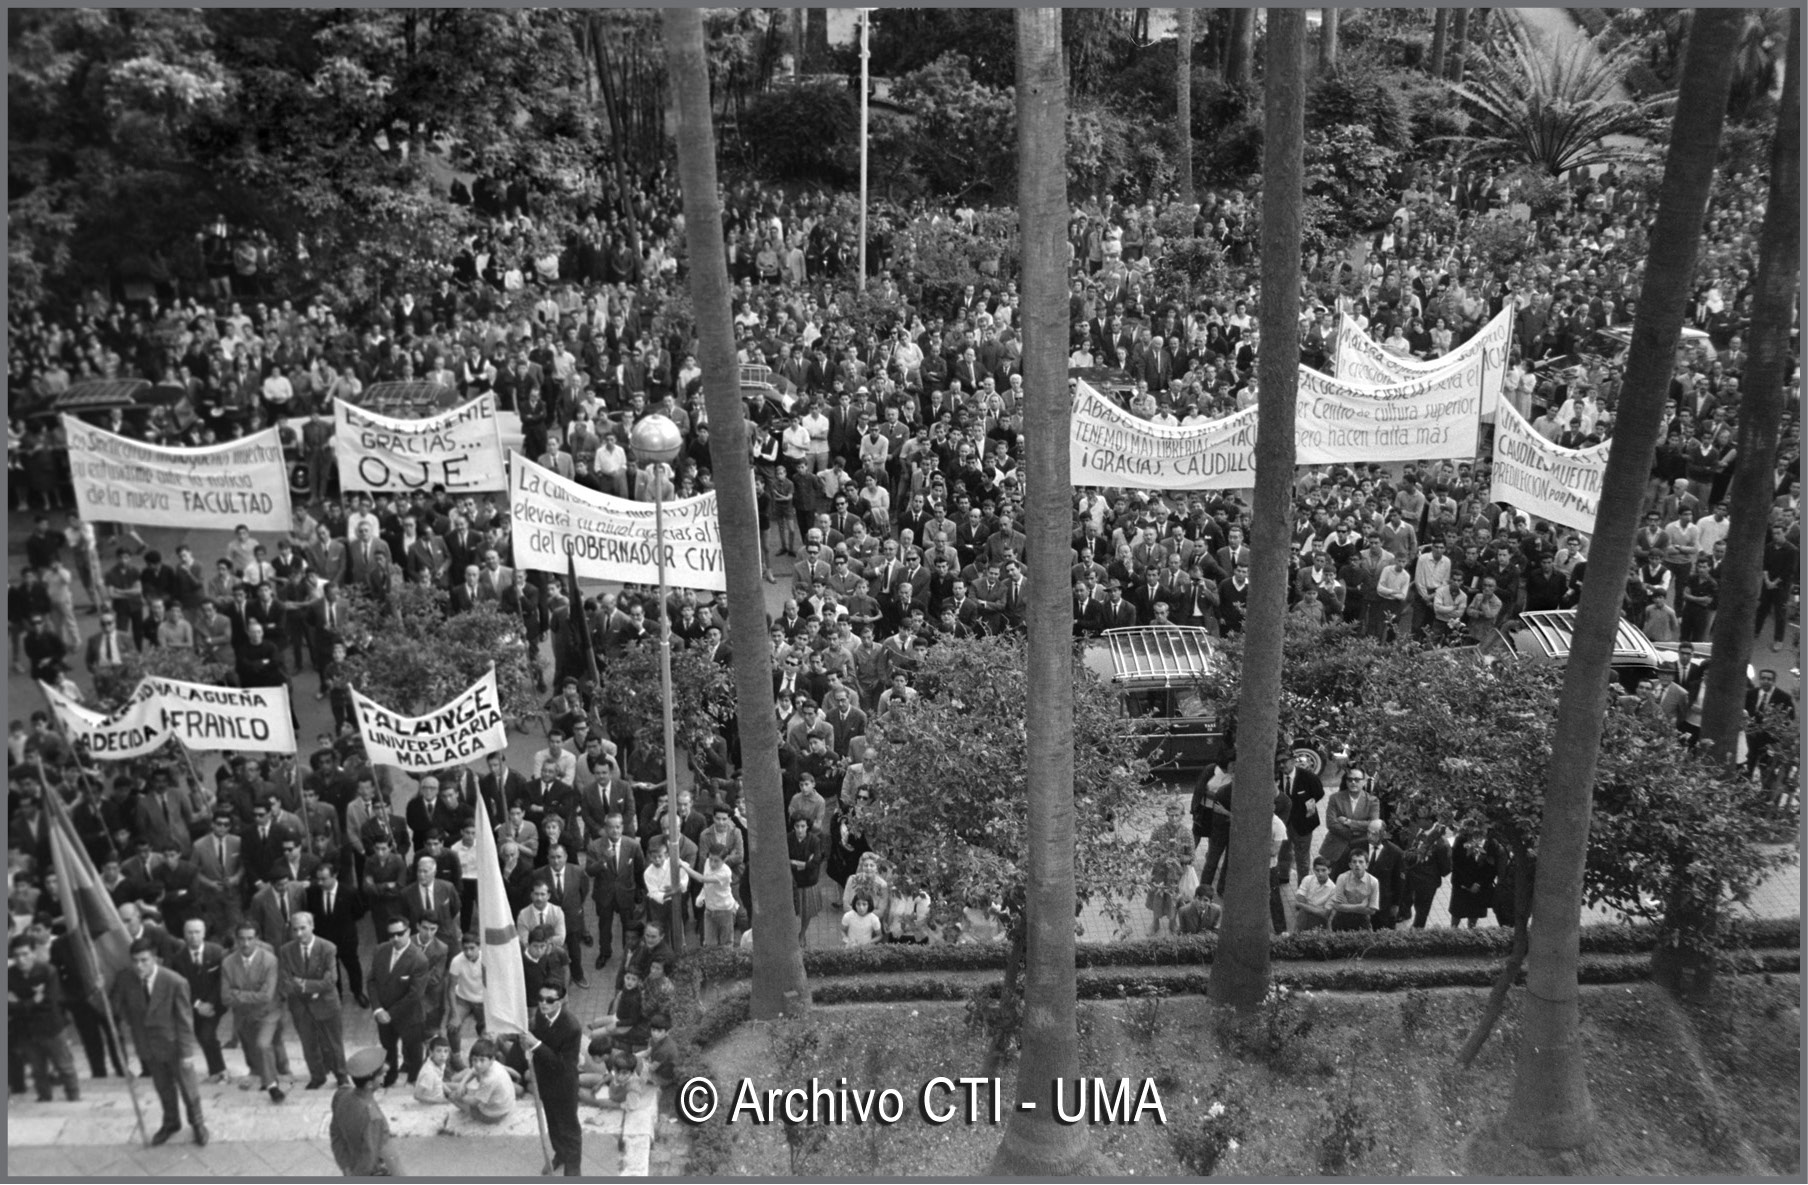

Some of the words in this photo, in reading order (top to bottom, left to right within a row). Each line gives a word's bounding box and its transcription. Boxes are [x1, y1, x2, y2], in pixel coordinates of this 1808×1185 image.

[1467, 364, 1479, 387] el
[1298, 401, 1309, 419] er
[1313, 397, 1355, 420] Centro
[1375, 402, 1418, 422] cultura
[361, 431, 482, 455] GRACIAS...
[1076, 420, 1129, 453] TENEMOS
[1131, 433, 1153, 458] MAS
[1157, 437, 1209, 460] LIBRERIAS
[1328, 424, 1369, 447] hacen
[1375, 425, 1409, 446] falta
[182, 490, 273, 515] FACULTAD
[519, 466, 541, 495] La
[692, 498, 719, 524] pue
[694, 520, 711, 543] al
[529, 528, 556, 555] del
[561, 533, 677, 569] GOBERNADOR
[685, 547, 723, 573] CIVI
[81, 725, 159, 753] ADECIDA
[170, 710, 270, 742] FRANCO
[368, 709, 502, 753] UNIVERSITARIA
[396, 736, 486, 767] MALAGA
